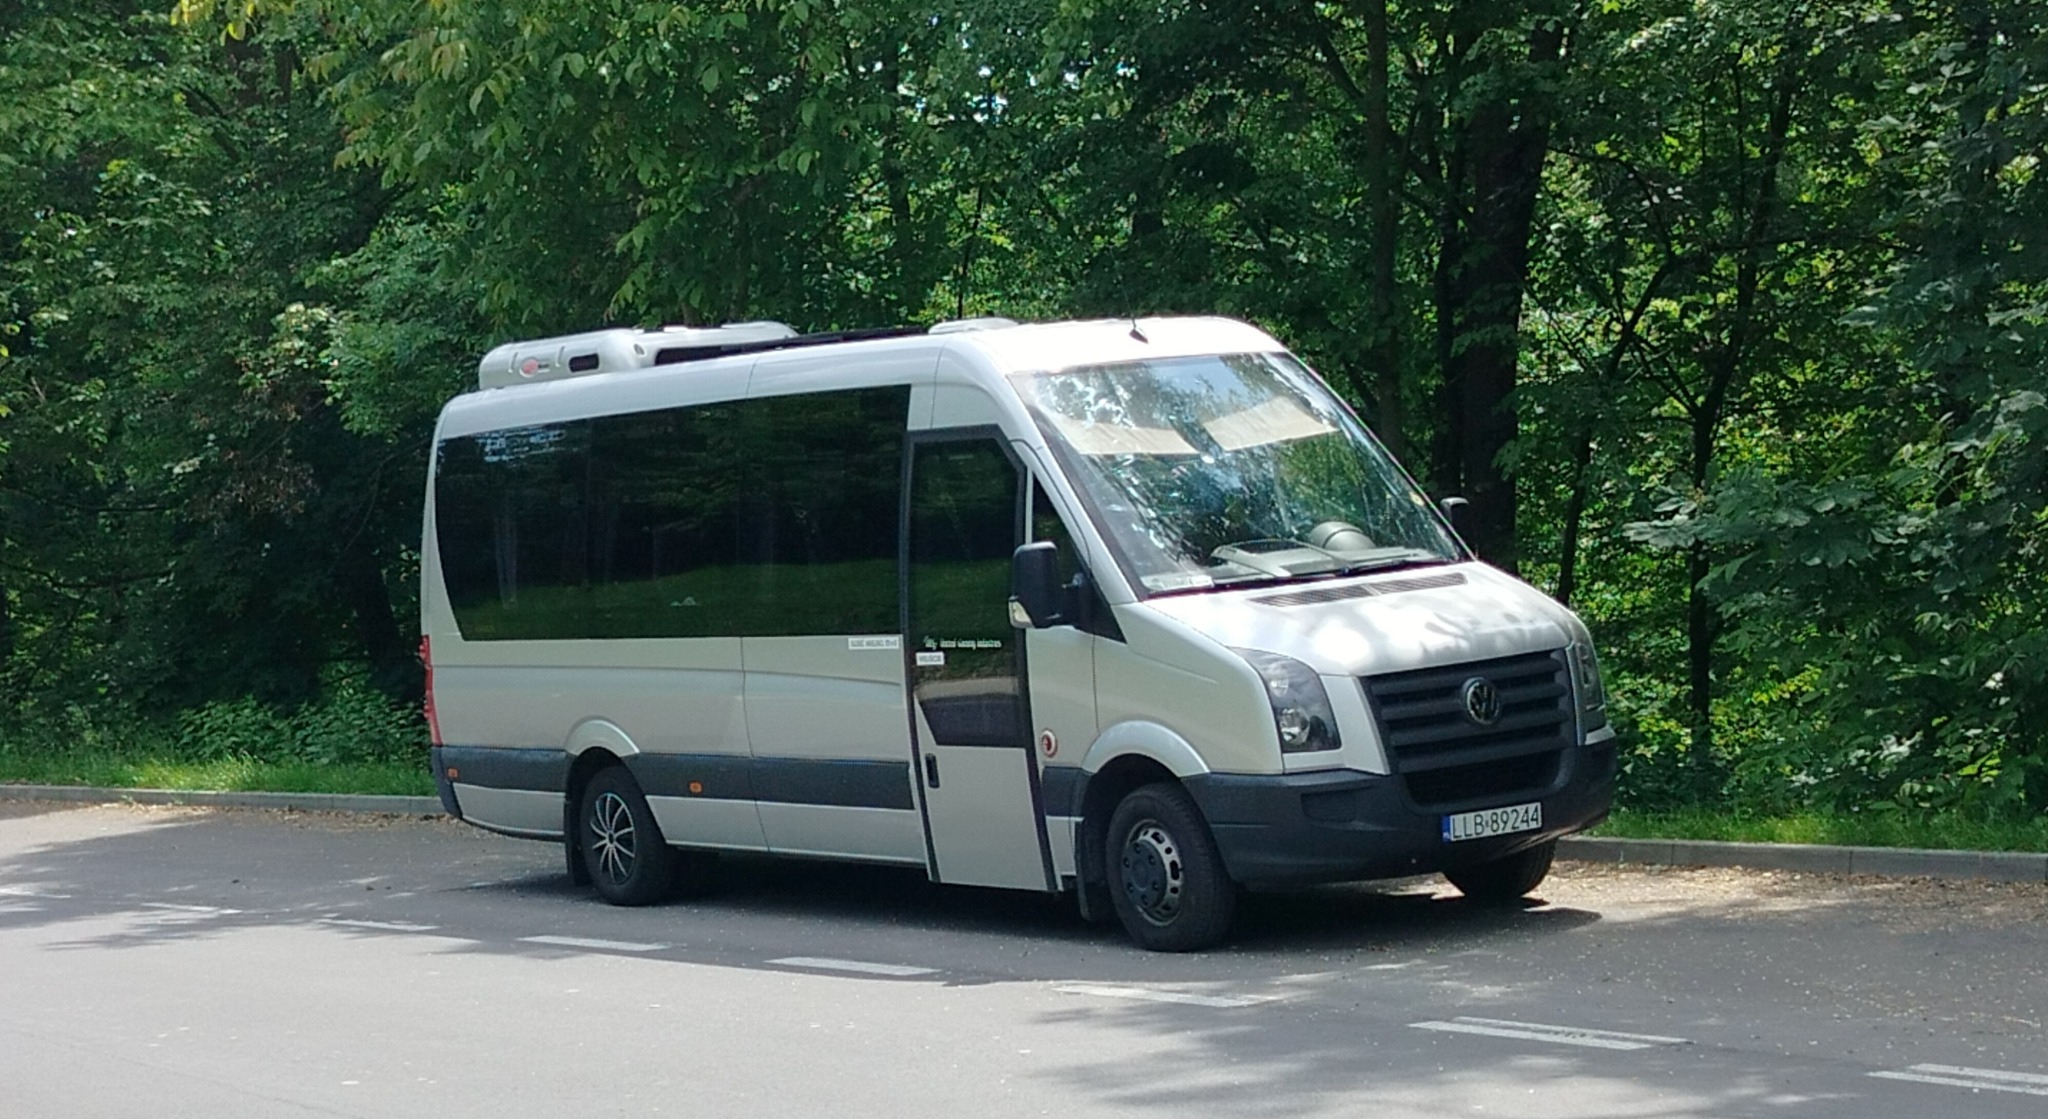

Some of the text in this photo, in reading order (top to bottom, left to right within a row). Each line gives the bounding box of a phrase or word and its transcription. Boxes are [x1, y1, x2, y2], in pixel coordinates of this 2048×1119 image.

[1467, 679, 1496, 723] VW
[1452, 805, 1539, 839] LLB 89244
